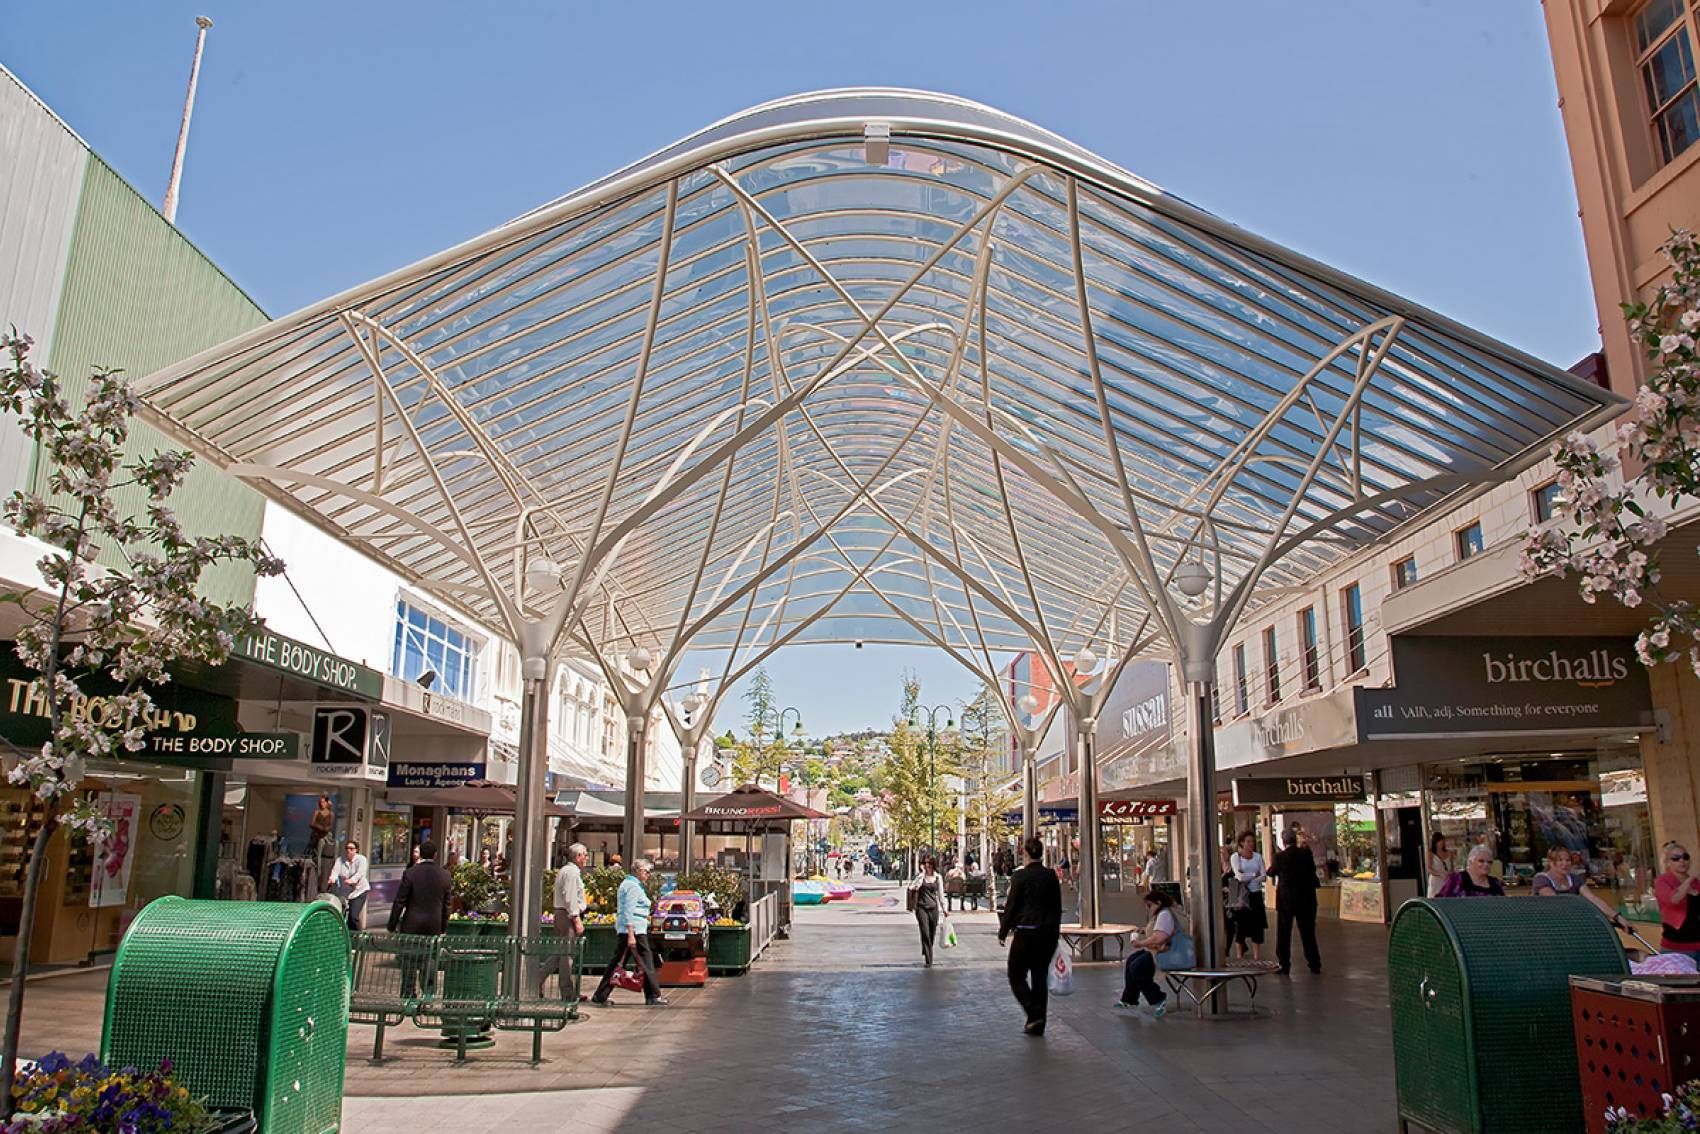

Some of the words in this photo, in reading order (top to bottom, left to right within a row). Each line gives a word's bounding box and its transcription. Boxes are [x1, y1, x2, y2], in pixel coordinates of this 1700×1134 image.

[247, 635, 277, 663] THE
[281, 642, 321, 677] BODY
[322, 657, 357, 690] SHOP.
[1483, 650, 1628, 683] birchalls
[1122, 693, 1167, 739] sussan
[1374, 706, 1393, 718] all
[1433, 705, 1455, 719] adj.
[1456, 703, 1522, 718] Something
[1525, 702, 1542, 715] for
[1545, 702, 1599, 716] everyone
[318, 710, 362, 760] R
[1254, 711, 1304, 747] birchalls
[153, 737, 183, 752] THE
[190, 737, 236, 753] BODY
[239, 738, 287, 754] SHOP.
[396, 764, 476, 778] Monaghans
[405, 778, 431, 786] Lucky
[1287, 778, 1362, 796] birchalls
